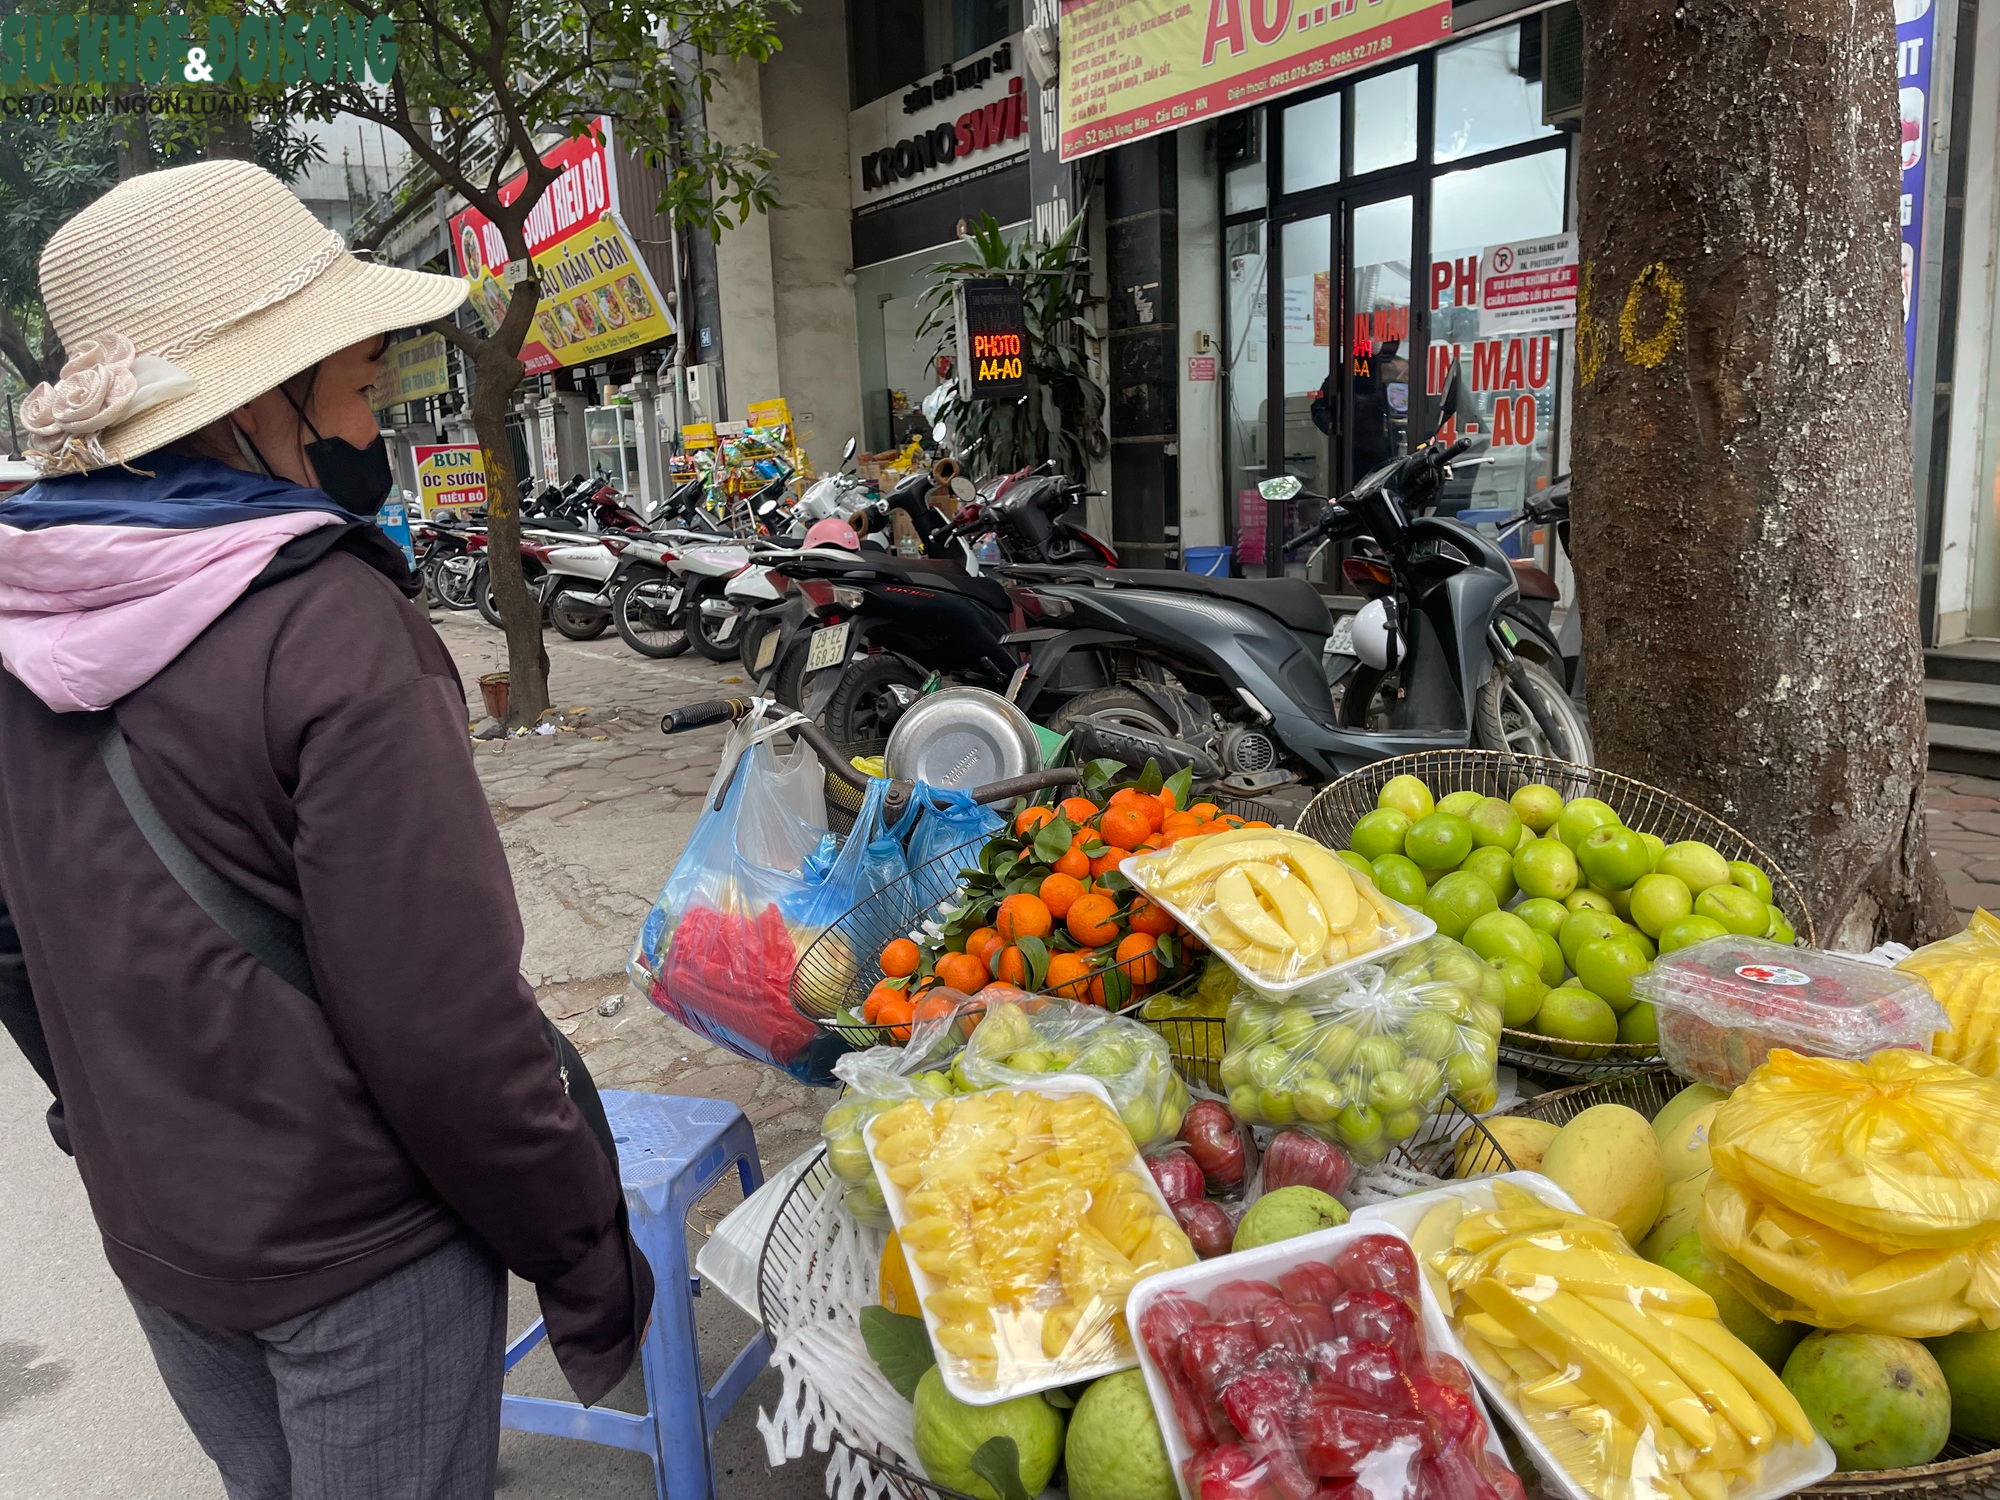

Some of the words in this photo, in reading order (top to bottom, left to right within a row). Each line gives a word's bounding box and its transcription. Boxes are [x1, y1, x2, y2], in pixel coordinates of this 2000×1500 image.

[1228, 83, 1245, 101] Điện
[1246, 79, 1268, 96] thoại:
[1269, 58, 1324, 87] 0983.076.205
[1329, 36, 1392, 68] 0986.92.77.88
[1085, 129, 1096, 144] 52
[1098, 127, 1114, 142] Dịch
[1115, 122, 1133, 137] Vọng
[1195, 96, 1208, 111] HN
[589, 235, 629, 274] TÔM
[510, 264, 520, 275] 54
[1493, 280, 1505, 290] VUI
[1506, 276, 1524, 289] LÒNG
[1525, 272, 1549, 286] KHÔNG
[1562, 270, 1572, 281] XE
[1552, 285, 1577, 298] CHUNG
[974, 333, 1021, 358] PHOTO
[433, 449, 471, 467] BÚN
[422, 470, 441, 487] ỐC
[446, 469, 485, 486] SƯỜN
[440, 491, 466, 503] RIÊU
[816, 627, 843, 649] 29-E2
[810, 644, 843, 668] 468.37
